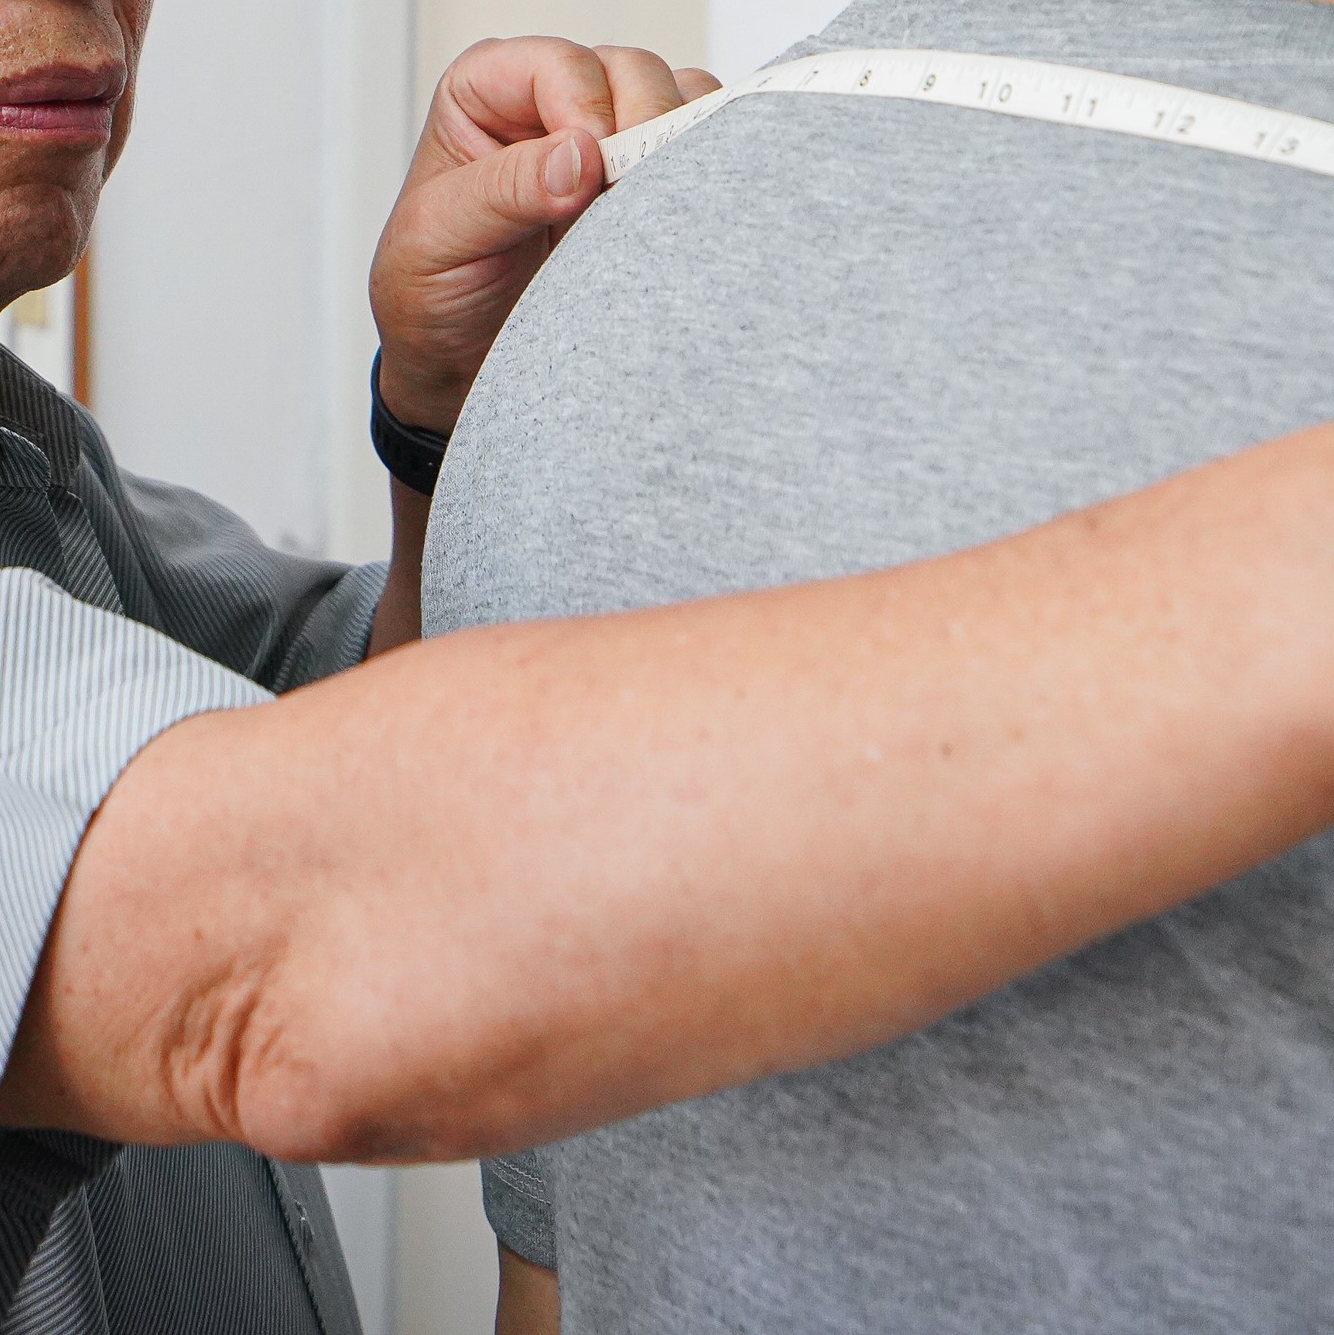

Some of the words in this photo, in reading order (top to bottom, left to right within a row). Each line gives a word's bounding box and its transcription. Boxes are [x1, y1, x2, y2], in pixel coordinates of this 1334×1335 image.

[922, 72, 937, 92] 9
[977, 80, 1014, 104] 10
[1061, 93, 1099, 118] 11
[1153, 111, 1197, 136] 12
[1253, 131, 1300, 156] 13
